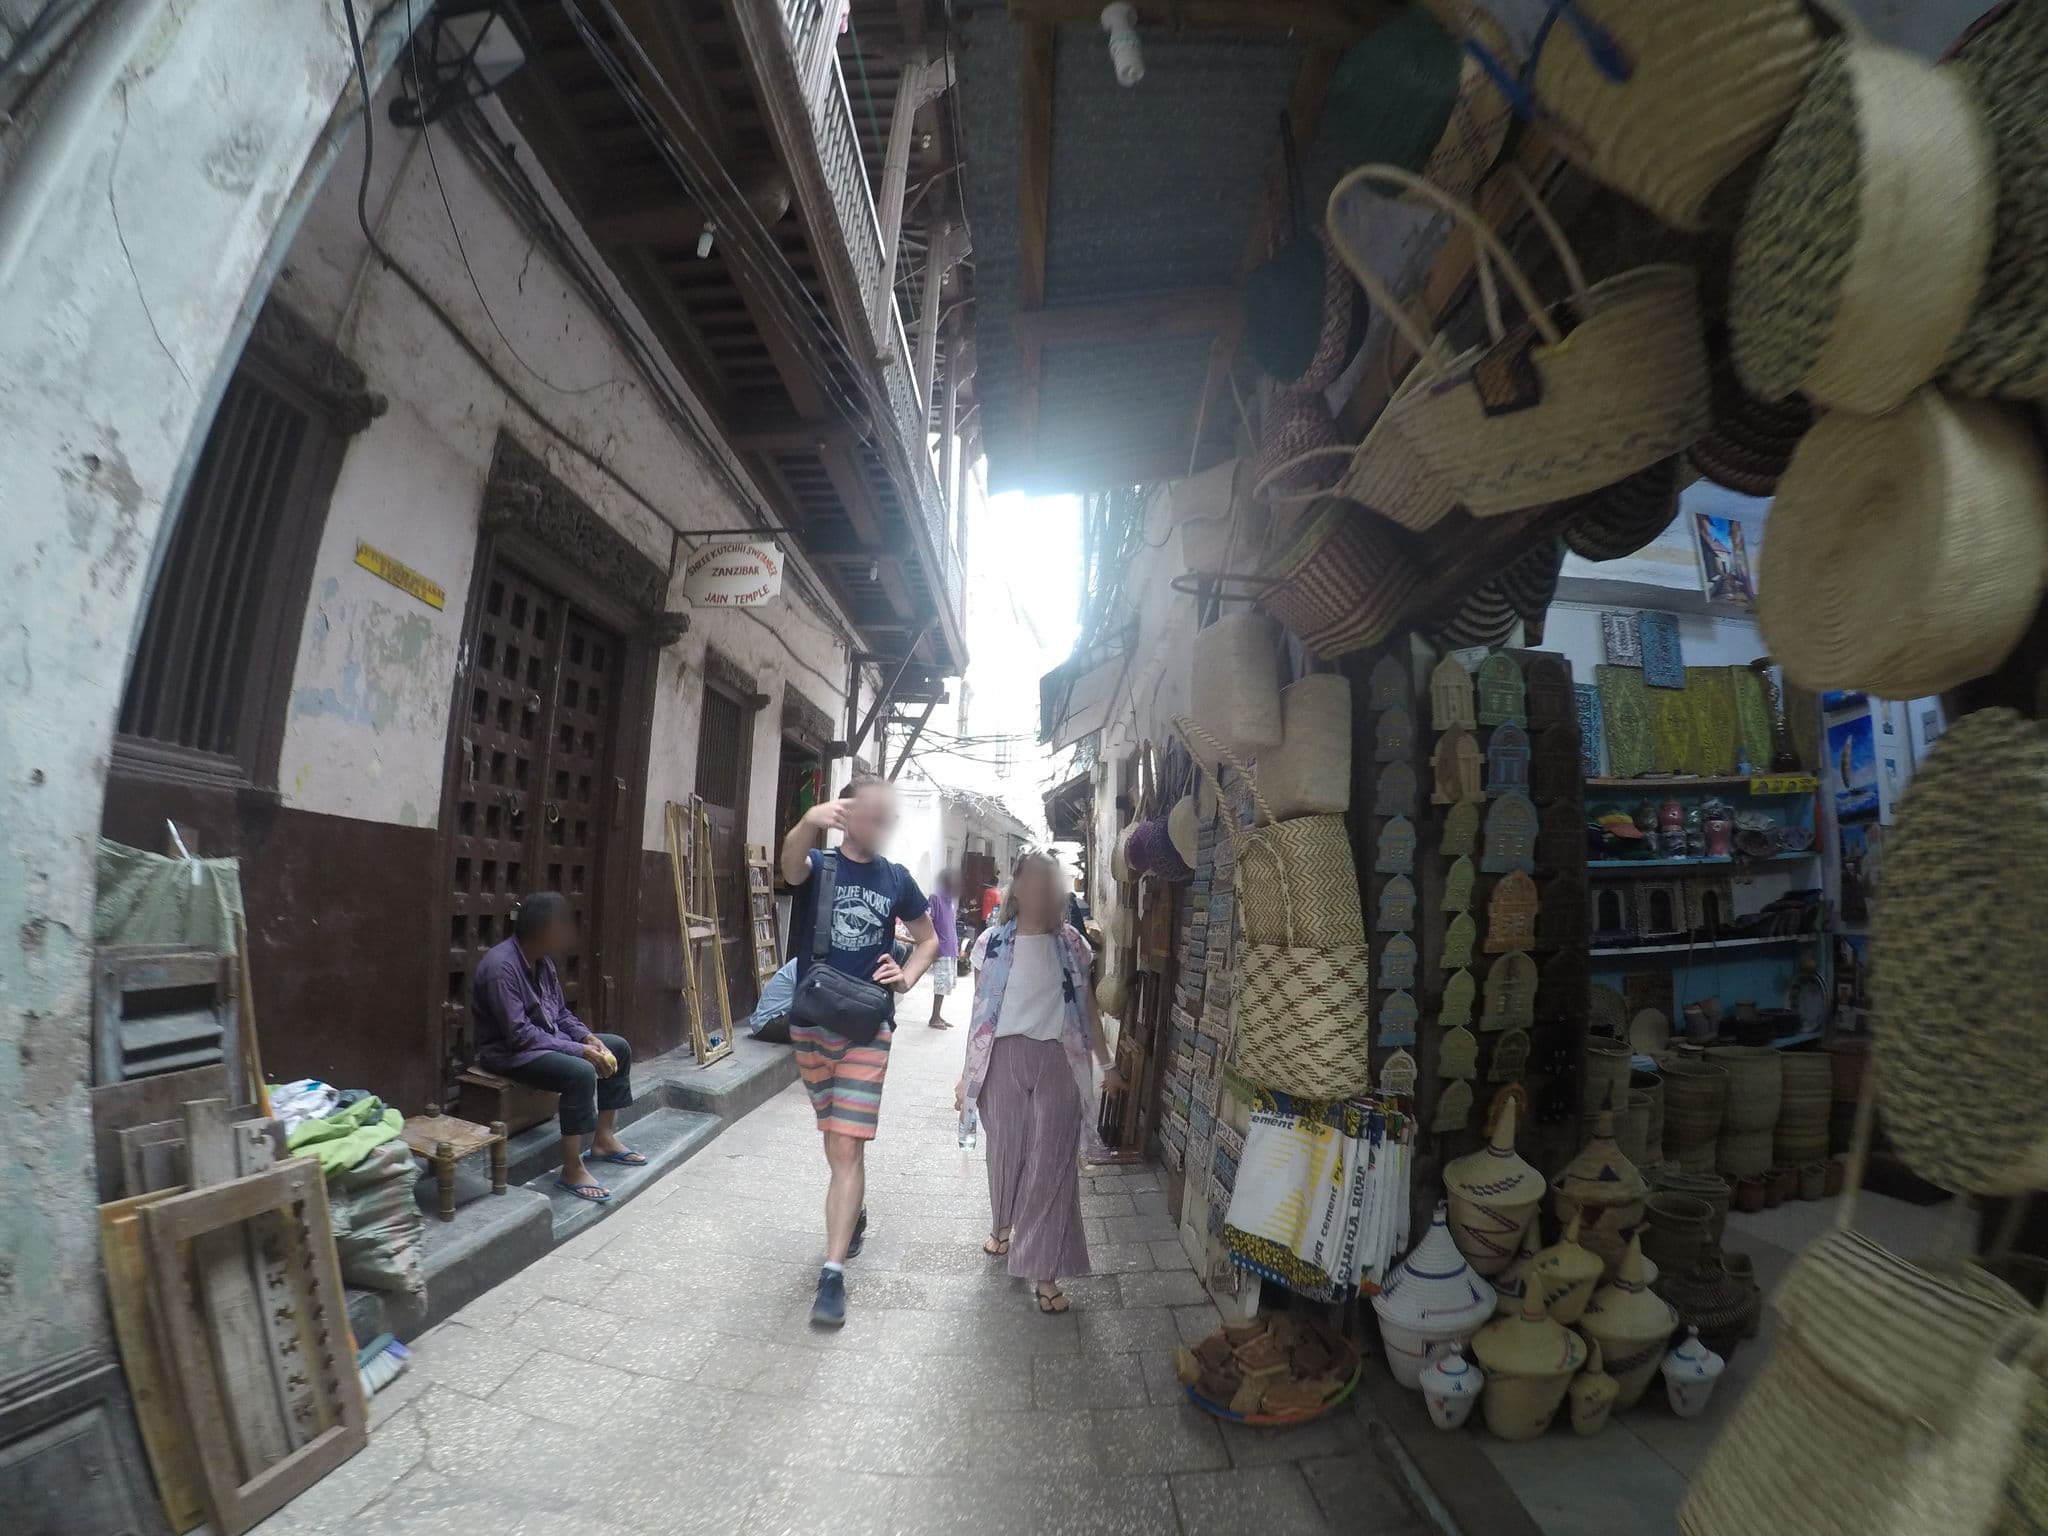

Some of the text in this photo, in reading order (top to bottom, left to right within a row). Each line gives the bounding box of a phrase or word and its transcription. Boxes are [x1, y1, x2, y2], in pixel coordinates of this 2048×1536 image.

[687, 554, 713, 577] SHREE
[711, 566, 760, 577] ZANZIBAR
[704, 584, 770, 604] JAIN TEMPLE
[862, 887, 891, 918] WORKS
[1251, 1114, 1295, 1130] ement
[1320, 1185, 1338, 1238] cement
